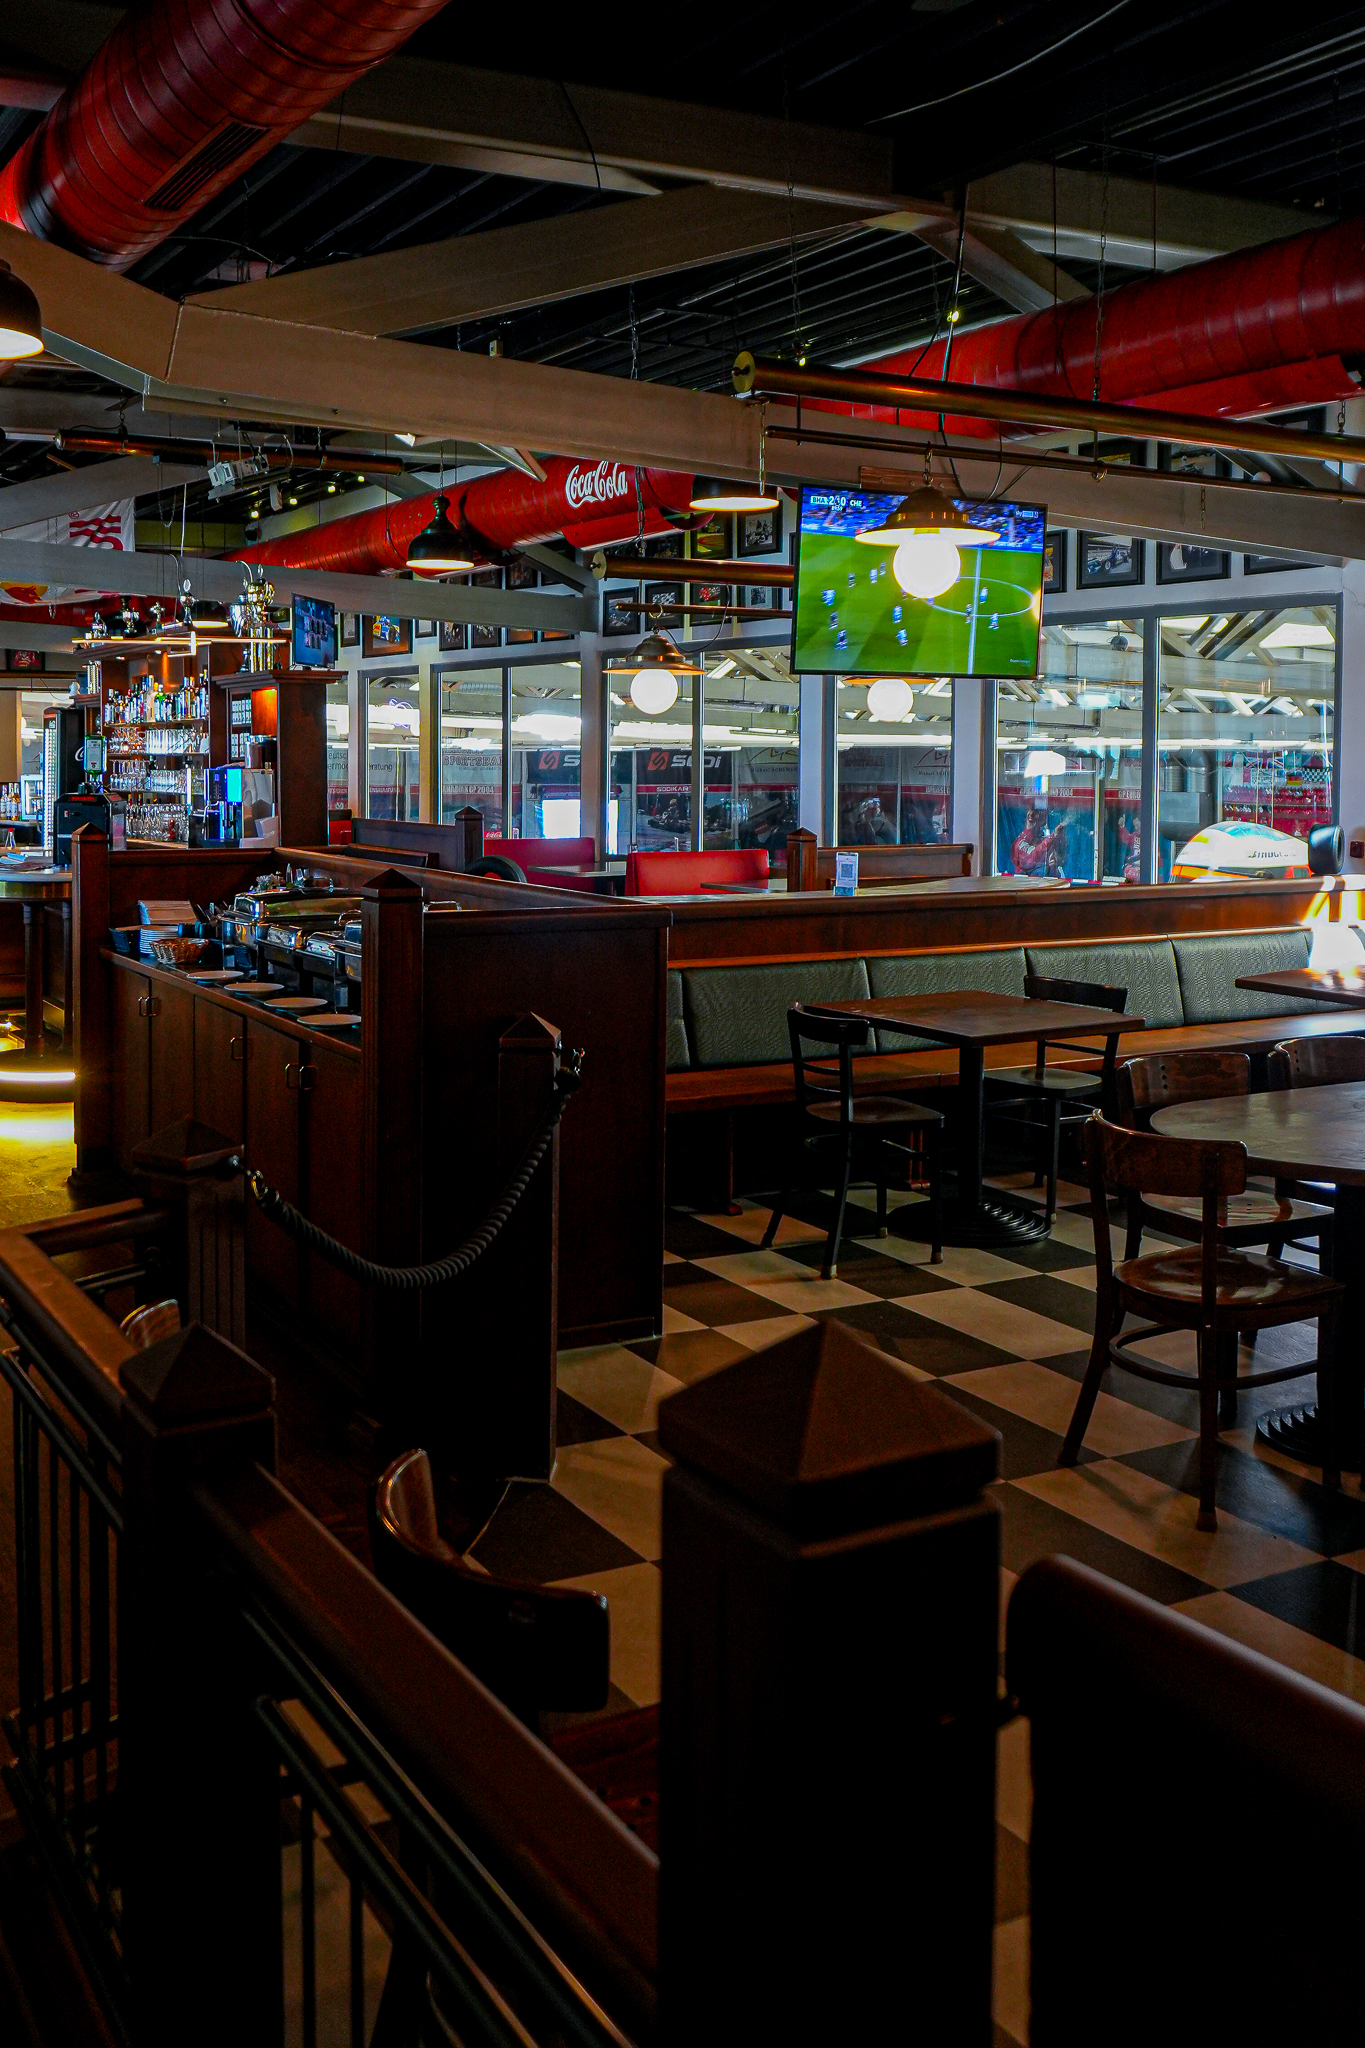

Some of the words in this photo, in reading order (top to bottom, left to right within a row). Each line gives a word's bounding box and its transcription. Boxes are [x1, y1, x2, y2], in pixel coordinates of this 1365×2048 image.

[565, 460, 628, 509] Coca-Cola
[811, 496, 828, 504] BHA
[829, 495, 835, 506] 2
[840, 496, 846, 506] 0
[850, 499, 863, 507] CHE
